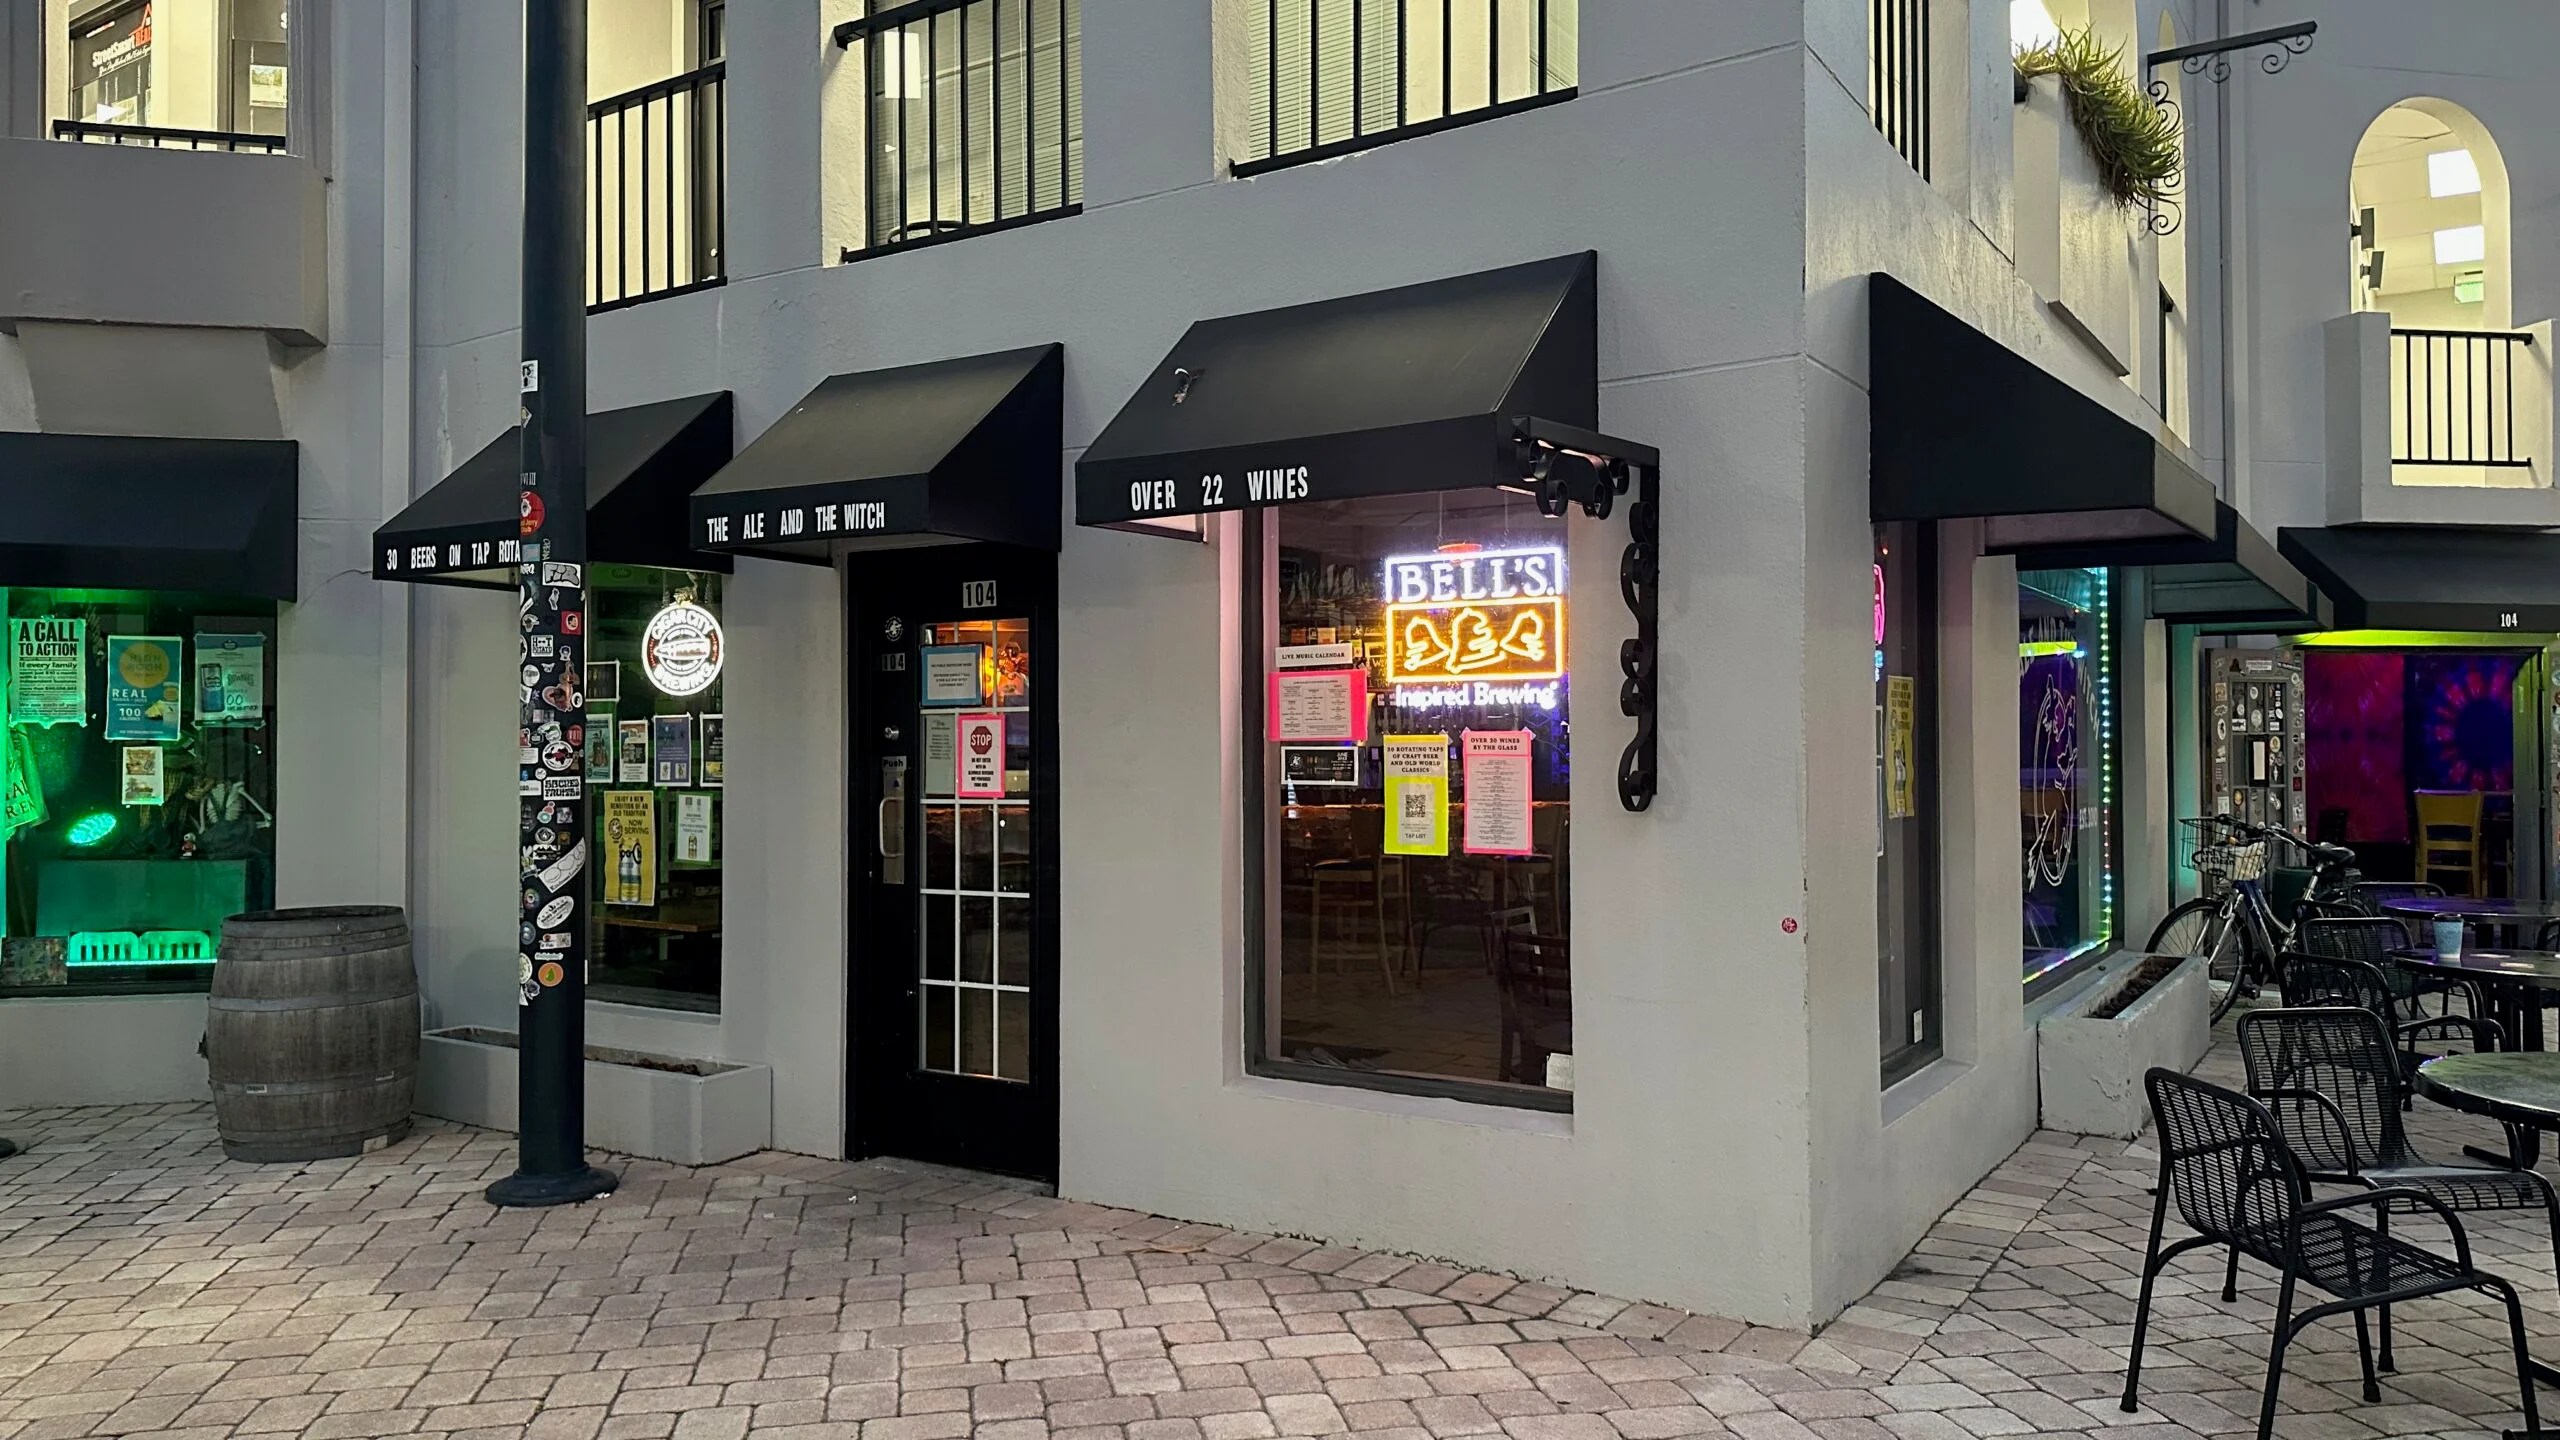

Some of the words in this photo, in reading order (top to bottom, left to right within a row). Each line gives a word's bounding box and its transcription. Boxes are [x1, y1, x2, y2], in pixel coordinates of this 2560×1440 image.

[1131, 479, 1176, 511] OVER
[1202, 474, 1224, 506] 22
[1247, 466, 1308, 501] WINES
[707, 517, 728, 543] THE
[743, 513, 764, 539] ALE
[780, 509, 803, 536] AND
[815, 505, 836, 532] THE
[844, 502, 885, 530] WITCH
[387, 549, 398, 570] 30
[411, 546, 437, 569] BEERS
[449, 544, 461, 567] ON
[471, 542, 490, 565] TAP
[965, 582, 995, 606] 104
[651, 608, 687, 640] CIGAR
[686, 610, 715, 635] CITY
[2501, 612, 2518, 627] 104
[19, 621, 31, 642] A
[34, 621, 79, 642] CALL
[18, 643, 33, 656] TO
[36, 643, 77, 656] ACTION
[52, 662, 77, 670] family
[884, 654, 903, 670] 104
[112, 688, 147, 698] REAL
[1396, 684, 1469, 711] Inspired
[119, 708, 141, 717] 100
[971, 734, 992, 746] STOP
[624, 827, 650, 835] SERVING
